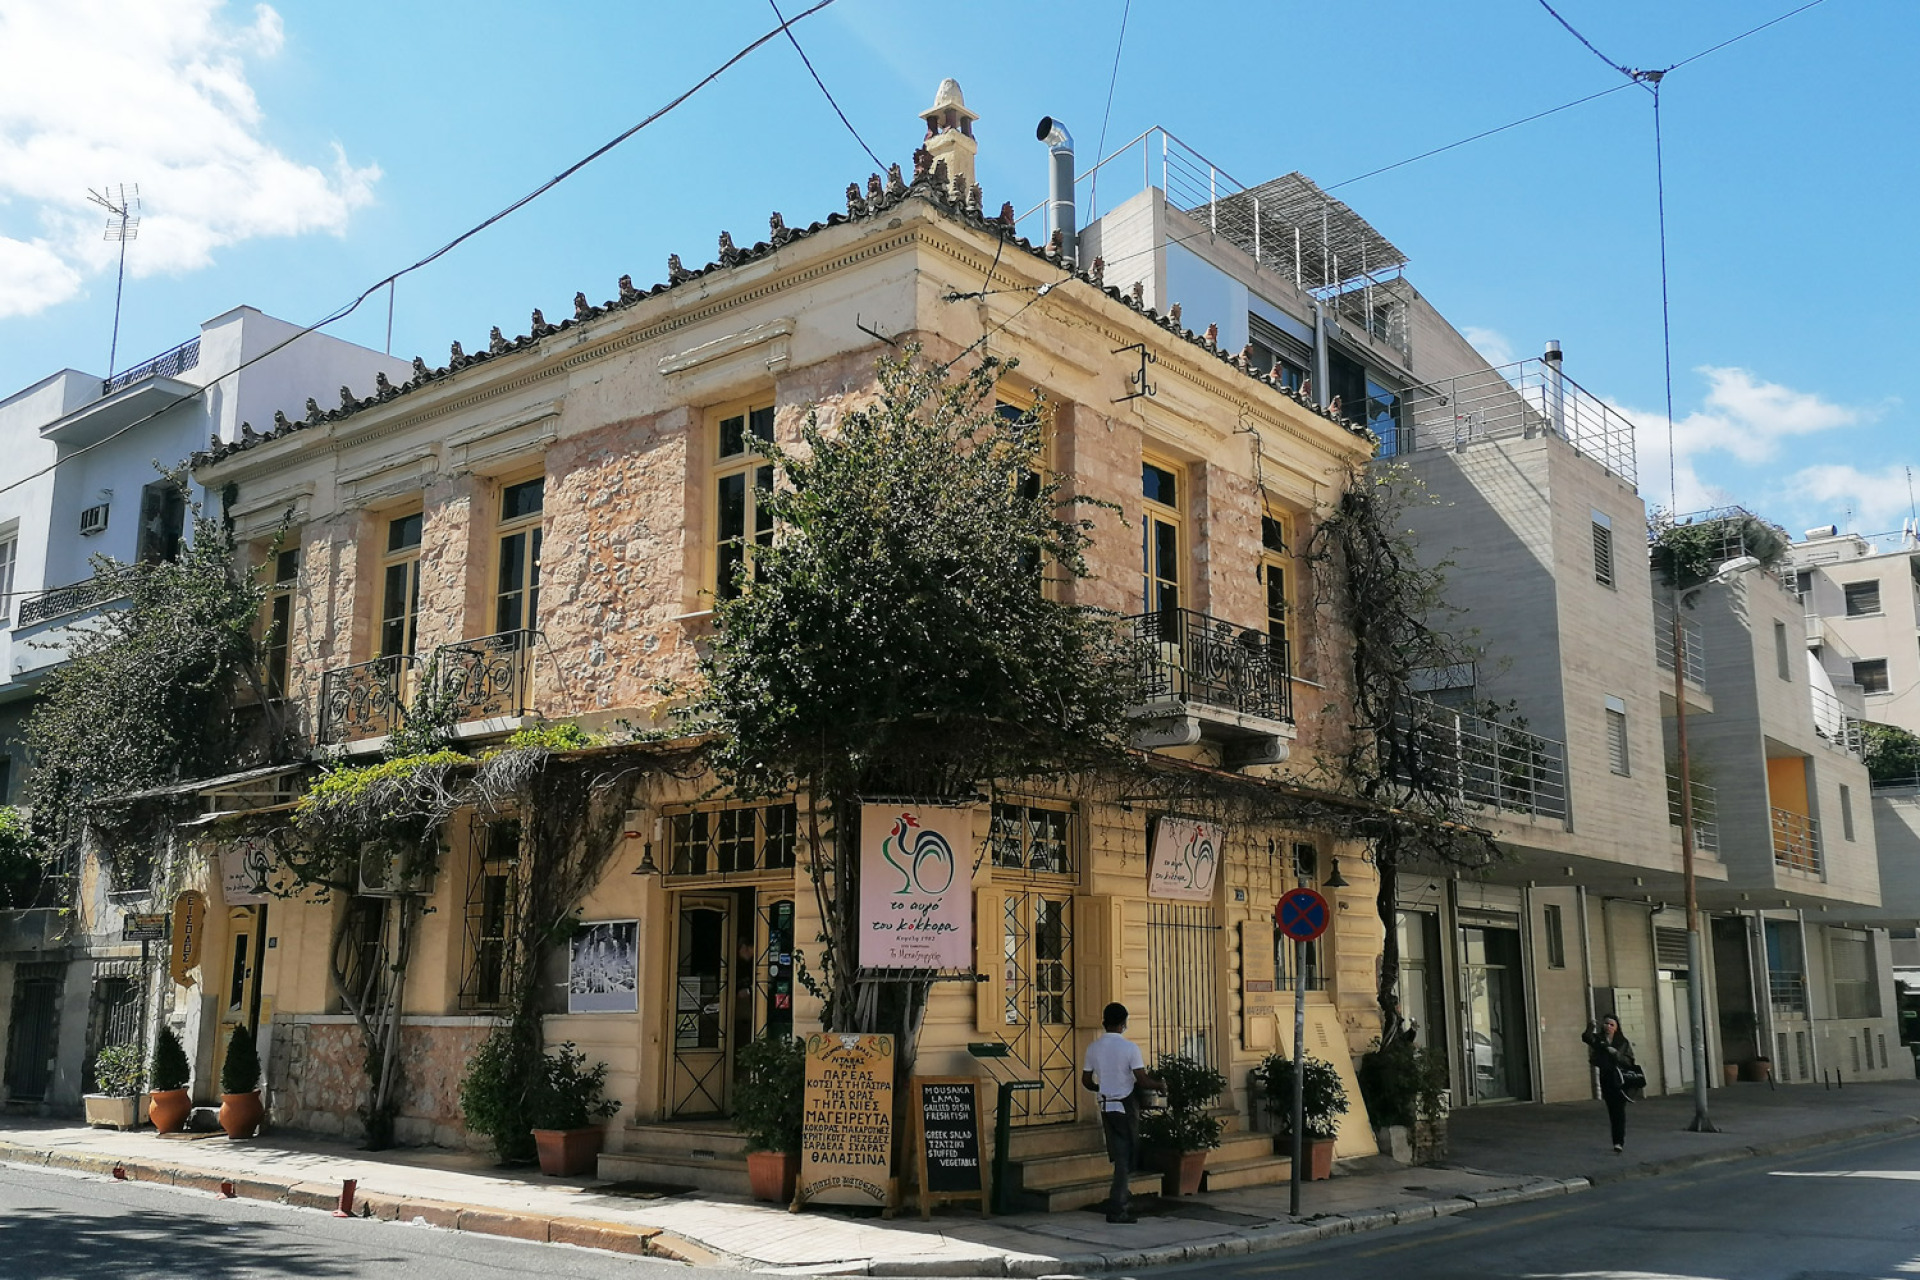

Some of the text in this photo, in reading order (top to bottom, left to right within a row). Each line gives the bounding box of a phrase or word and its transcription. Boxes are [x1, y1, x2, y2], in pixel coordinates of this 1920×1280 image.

[891, 897, 943, 917] το αυγό
[182, 896, 194, 963] ΕΙΣΟΔΟΣ
[872, 917, 959, 935] του κόκκορα
[823, 1070, 874, 1081] ΠΑΡΕΑΣ
[807, 1079, 833, 1089] ΚΟΤΣΙ
[825, 1089, 874, 1100] ΤΗΣ ΩΡΑΣ
[924, 1086, 971, 1094] MOUSAKA
[812, 1099, 880, 1112] ΤΗΓΑΝΙΕΣ
[924, 1103, 971, 1112] GRILLED DISH
[806, 1110, 890, 1126] ΜΑΓΕΙΡΕΥΤΑ
[926, 1112, 970, 1120] FRESH FISH
[804, 1124, 839, 1133] ΚΟΚΟΡΑΣ
[803, 1133, 889, 1144] ΚΡΗΤΙΚΟΥΣ ΜΕΖΕΔΕΣ
[925, 1130, 973, 1139] GREEK SALAD
[803, 1142, 886, 1153] ΣΑΡΔΕΛΑ ΣΧΑΡΑΣ
[928, 1140, 965, 1149] TZATZIKI
[811, 1151, 887, 1166] ΘΑΛΑΣΣΙΝΑ
[927, 1149, 958, 1158] STUFFED
[939, 1158, 978, 1167] VEGETABLE
